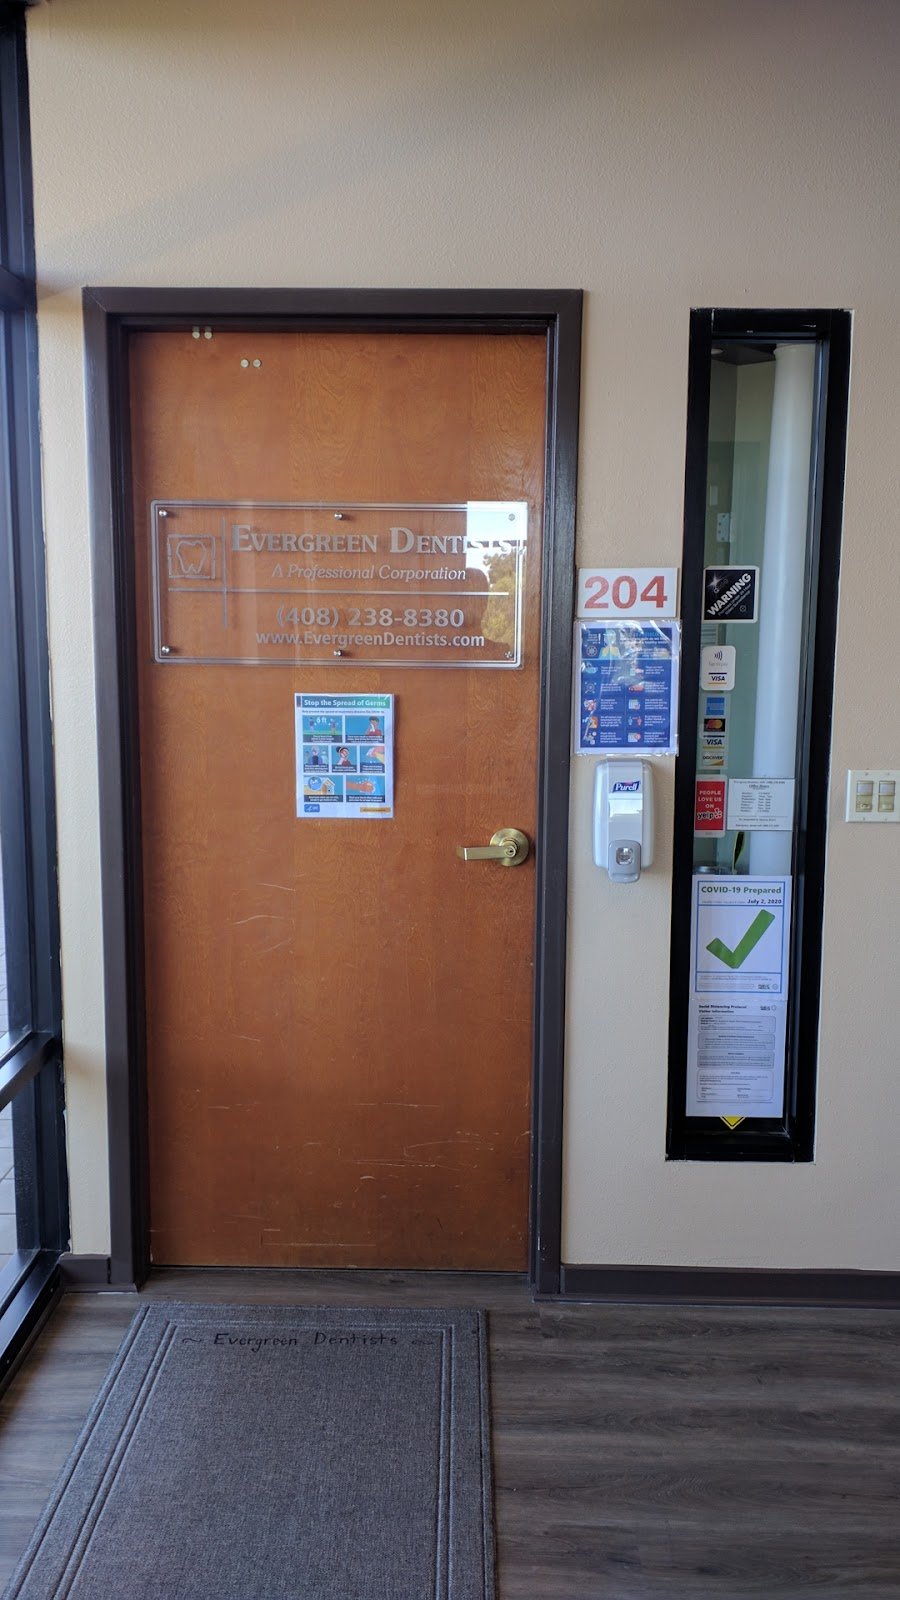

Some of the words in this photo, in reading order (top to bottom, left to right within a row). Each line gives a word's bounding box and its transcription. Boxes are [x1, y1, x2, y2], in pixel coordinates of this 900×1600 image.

[231, 524, 378, 553] EVERGREEN
[272, 563, 283, 578] A
[288, 564, 375, 580] Professional
[379, 565, 466, 582] Corporation
[584, 575, 668, 609] 204
[707, 573, 752, 616] WARNING
[276, 607, 340, 628] (408)
[348, 608, 465, 628] 238-8380
[255, 631, 485, 649] www.EvergreenDentists.com
[615, 782, 638, 791] Purell
[697, 811, 714, 820] yelp
[743, 886, 782, 895] Prepared
[213, 1332, 298, 1352] Evergreen
[313, 1332, 398, 1346] Dentists
